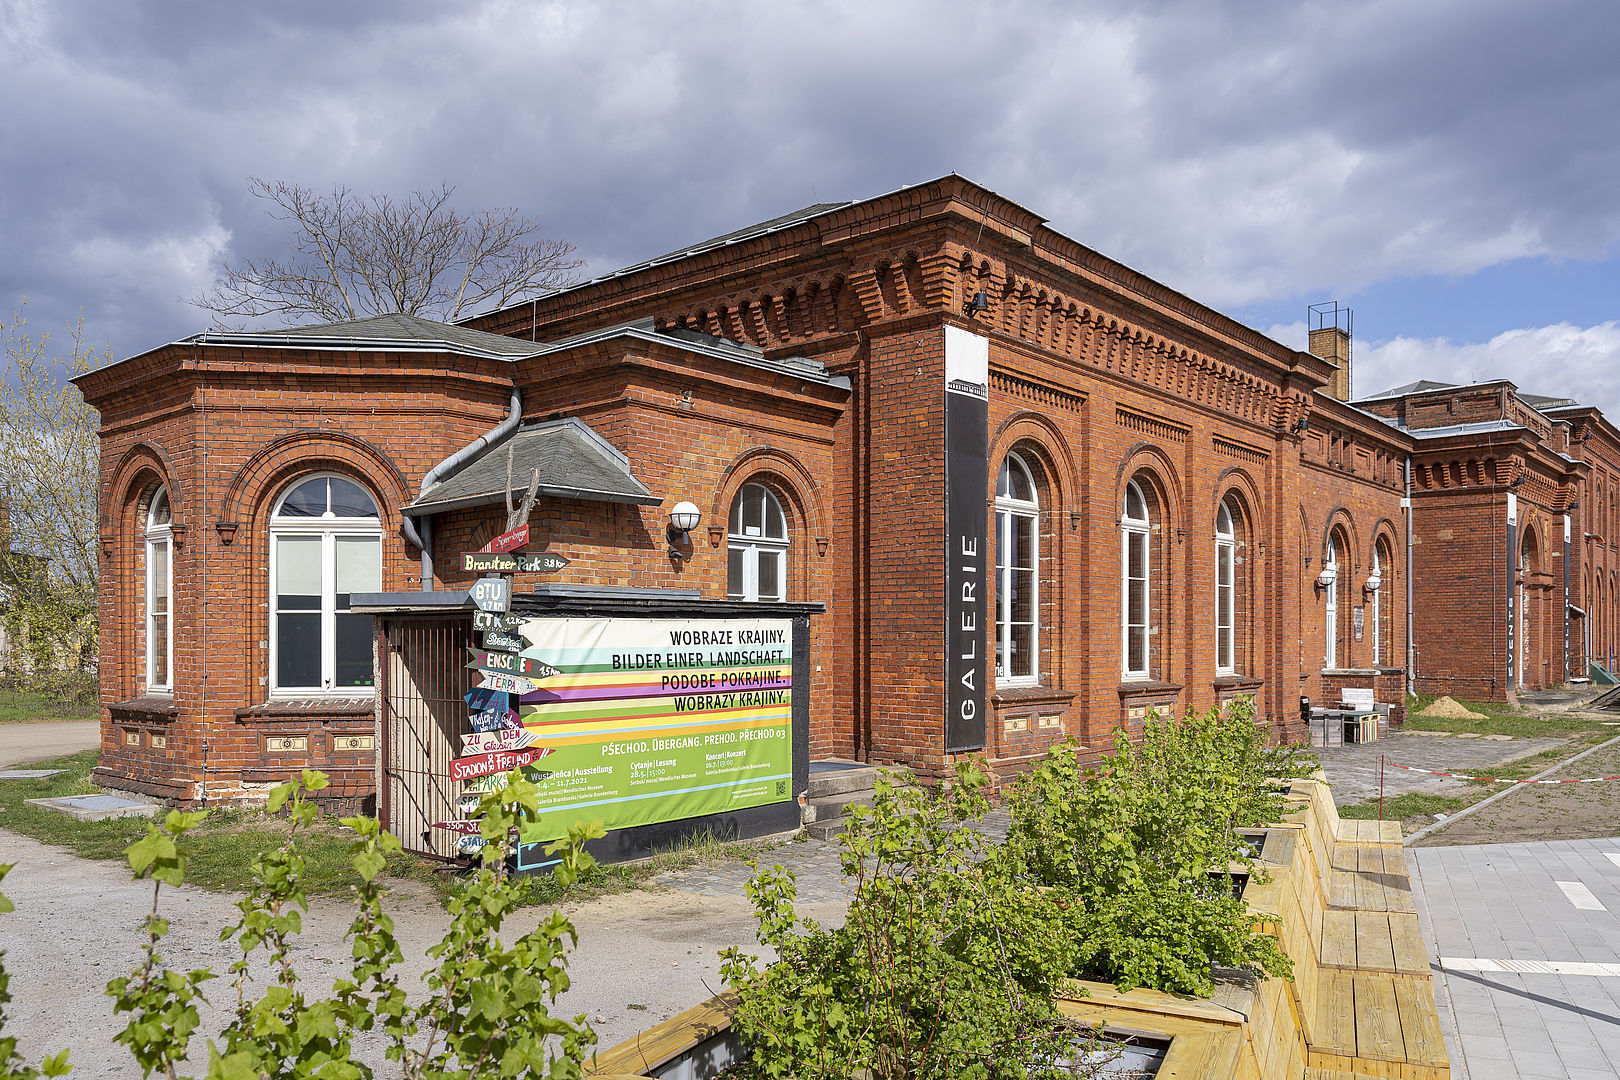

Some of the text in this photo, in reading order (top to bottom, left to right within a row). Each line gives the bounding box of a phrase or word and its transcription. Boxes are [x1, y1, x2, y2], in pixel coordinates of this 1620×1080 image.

[464, 554, 516, 570] Branitzer
[517, 556, 541, 572] Park
[475, 583, 501, 600] BTU
[475, 612, 503, 629] CTK
[960, 535, 977, 721] GALERIE
[670, 629, 786, 647] WOBRAZE KRAJINY.
[477, 652, 533, 673] MENSCHEN
[612, 650, 786, 670] BILDER EINER LANDSCHAFT.
[661, 670, 786, 690] PODOBE POKRAJINE.
[674, 690, 786, 712] WOBRAZY KRAJINY.
[467, 730, 520, 746] ZU DEN
[601, 728, 786, 757] PŚECHOD. ÜBERGANG. PREHOD. PŘECHOD 03
[454, 762, 488, 779] STADION
[477, 775, 503, 792] PARK
